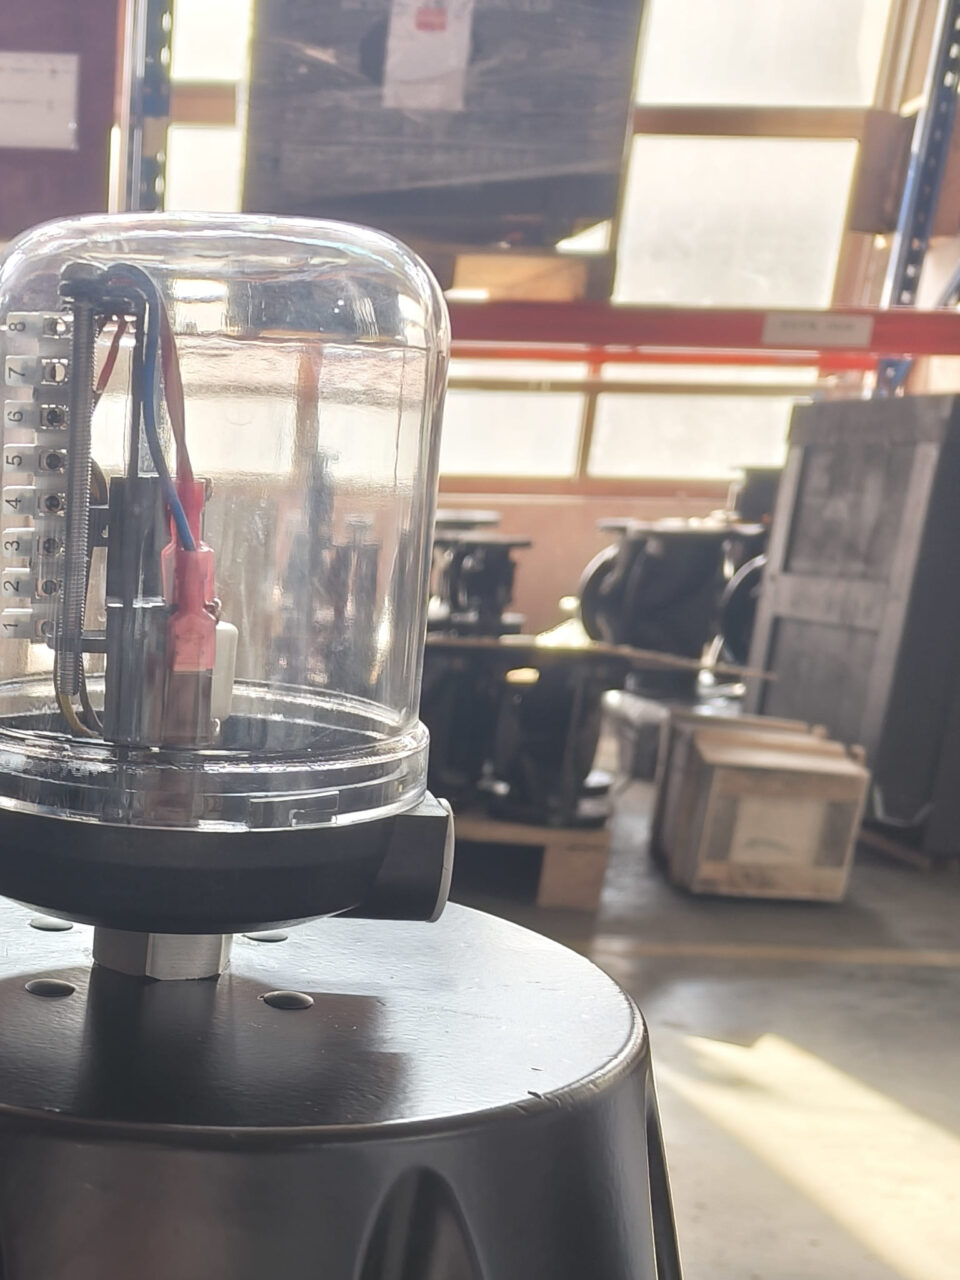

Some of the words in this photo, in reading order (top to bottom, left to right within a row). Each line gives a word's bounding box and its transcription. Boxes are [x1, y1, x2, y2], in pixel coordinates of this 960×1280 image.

[8, 321, 26, 332] 8
[8, 367, 26, 379] 7
[7, 410, 23, 422] 6
[5, 455, 22, 466] 5
[5, 498, 21, 510] 4
[4, 540, 20, 551] 3
[3, 580, 19, 592] 2
[2, 623, 18, 631] 1
